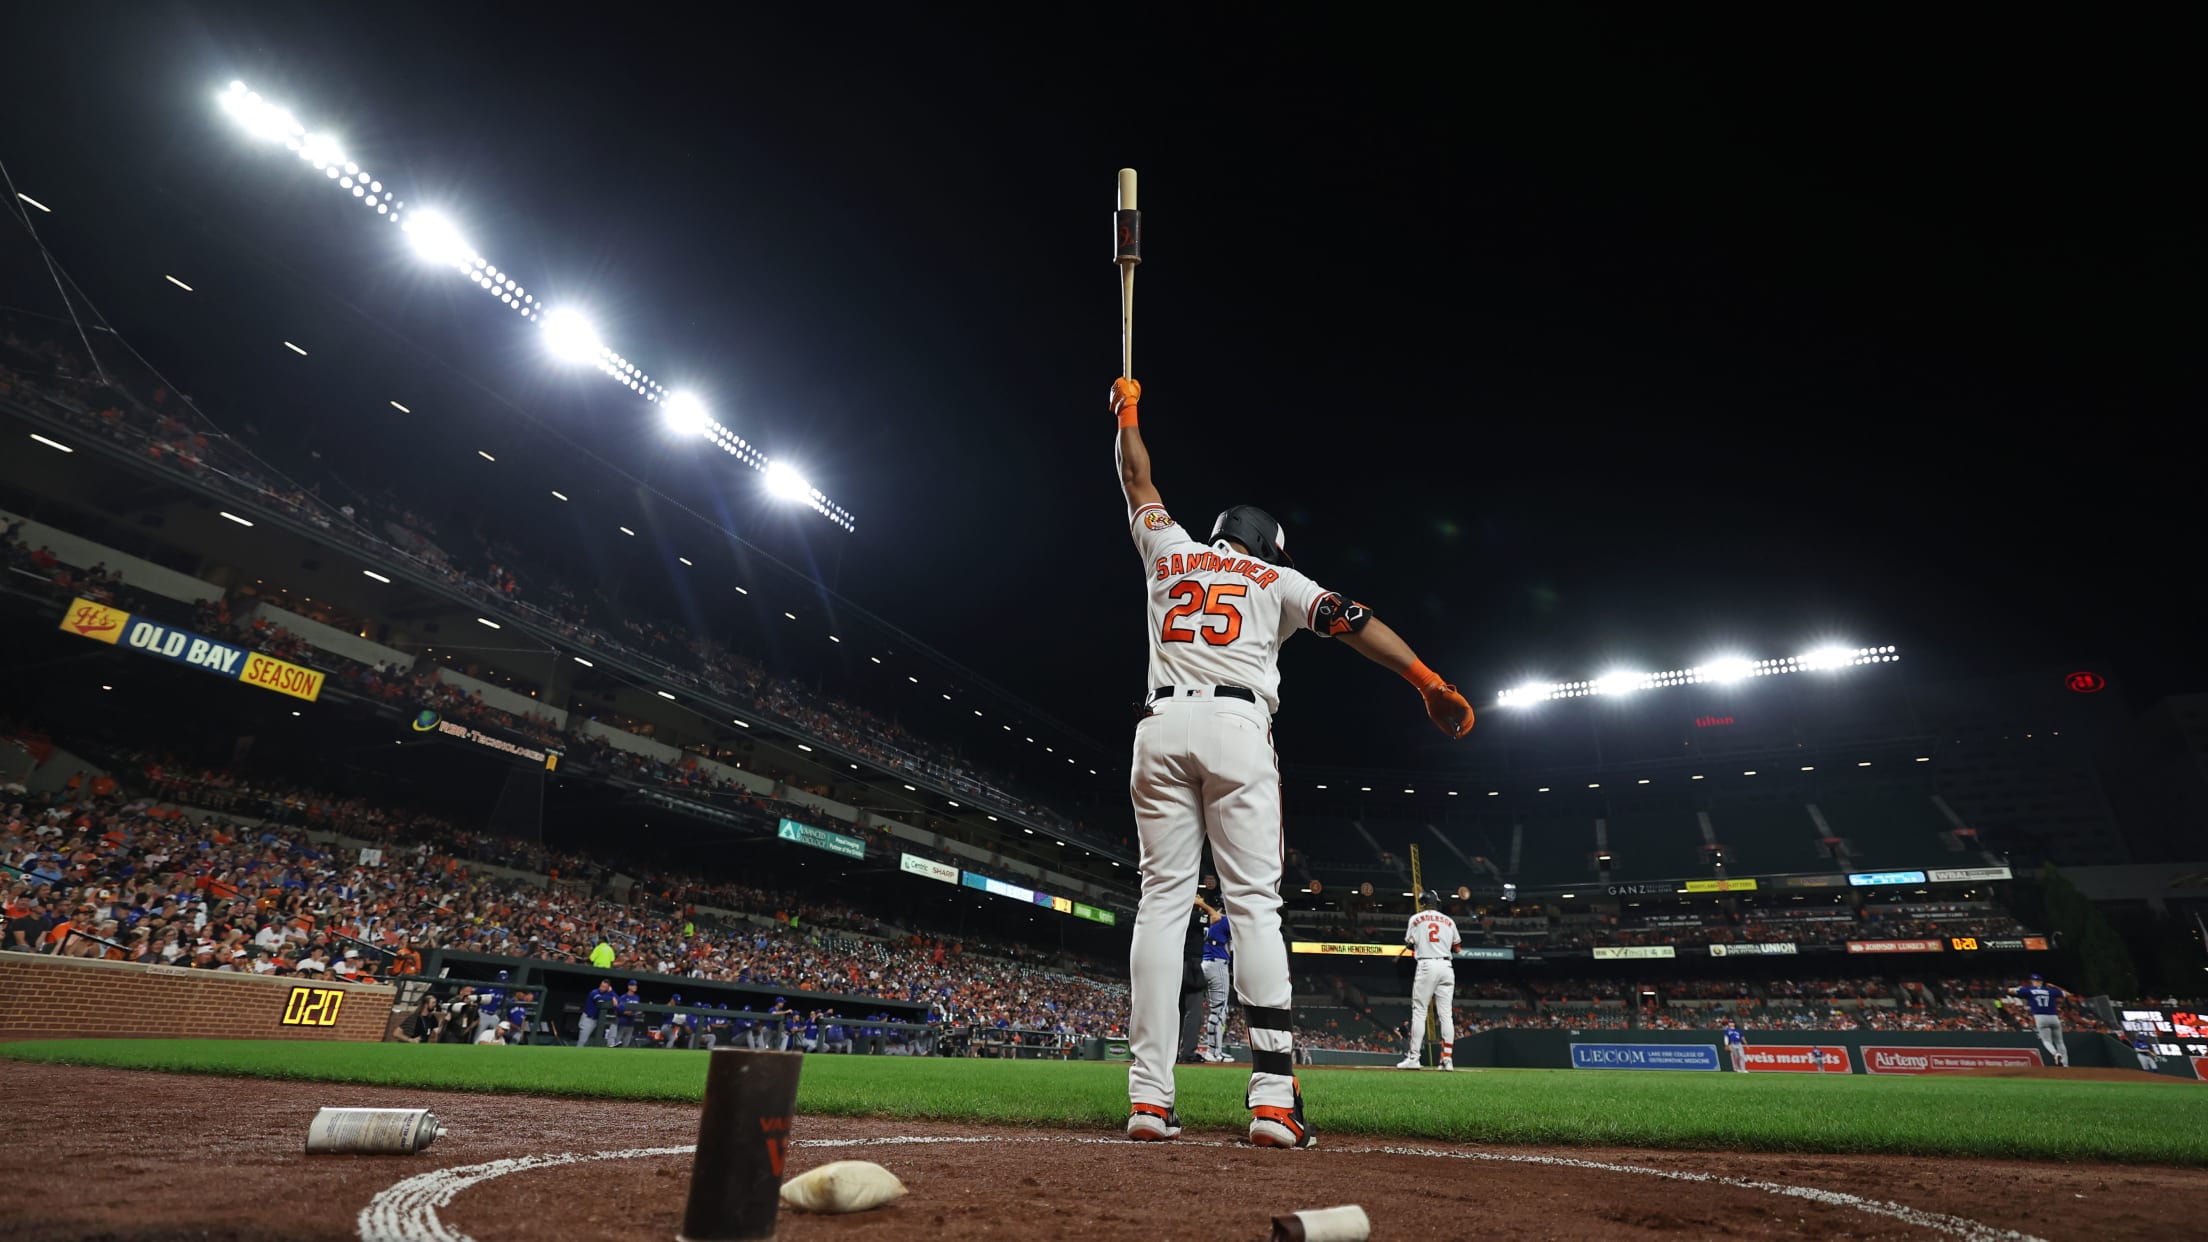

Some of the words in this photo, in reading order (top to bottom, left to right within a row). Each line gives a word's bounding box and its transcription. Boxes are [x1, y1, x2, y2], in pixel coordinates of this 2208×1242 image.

[1156, 551, 1279, 590] SANTANDER
[1161, 579, 1248, 647] 25
[72, 608, 117, 633] It's
[129, 621, 186, 658] OLD
[186, 638, 241, 673] BAY
[248, 658, 317, 697] SEASON
[932, 866, 955, 878] SHARP
[1608, 885, 1647, 895] GANZ
[1413, 915, 1453, 927] HENDERSON
[1428, 922, 1440, 942] 2
[1321, 944, 1347, 953] GUNNAR
[1347, 945, 1383, 954] HENDERSON
[1760, 943, 1797, 953] UNION
[1744, 1052, 1776, 1065] weis
[1777, 1053, 1841, 1065] markts
[1876, 1052, 1928, 1069] Airtemp
